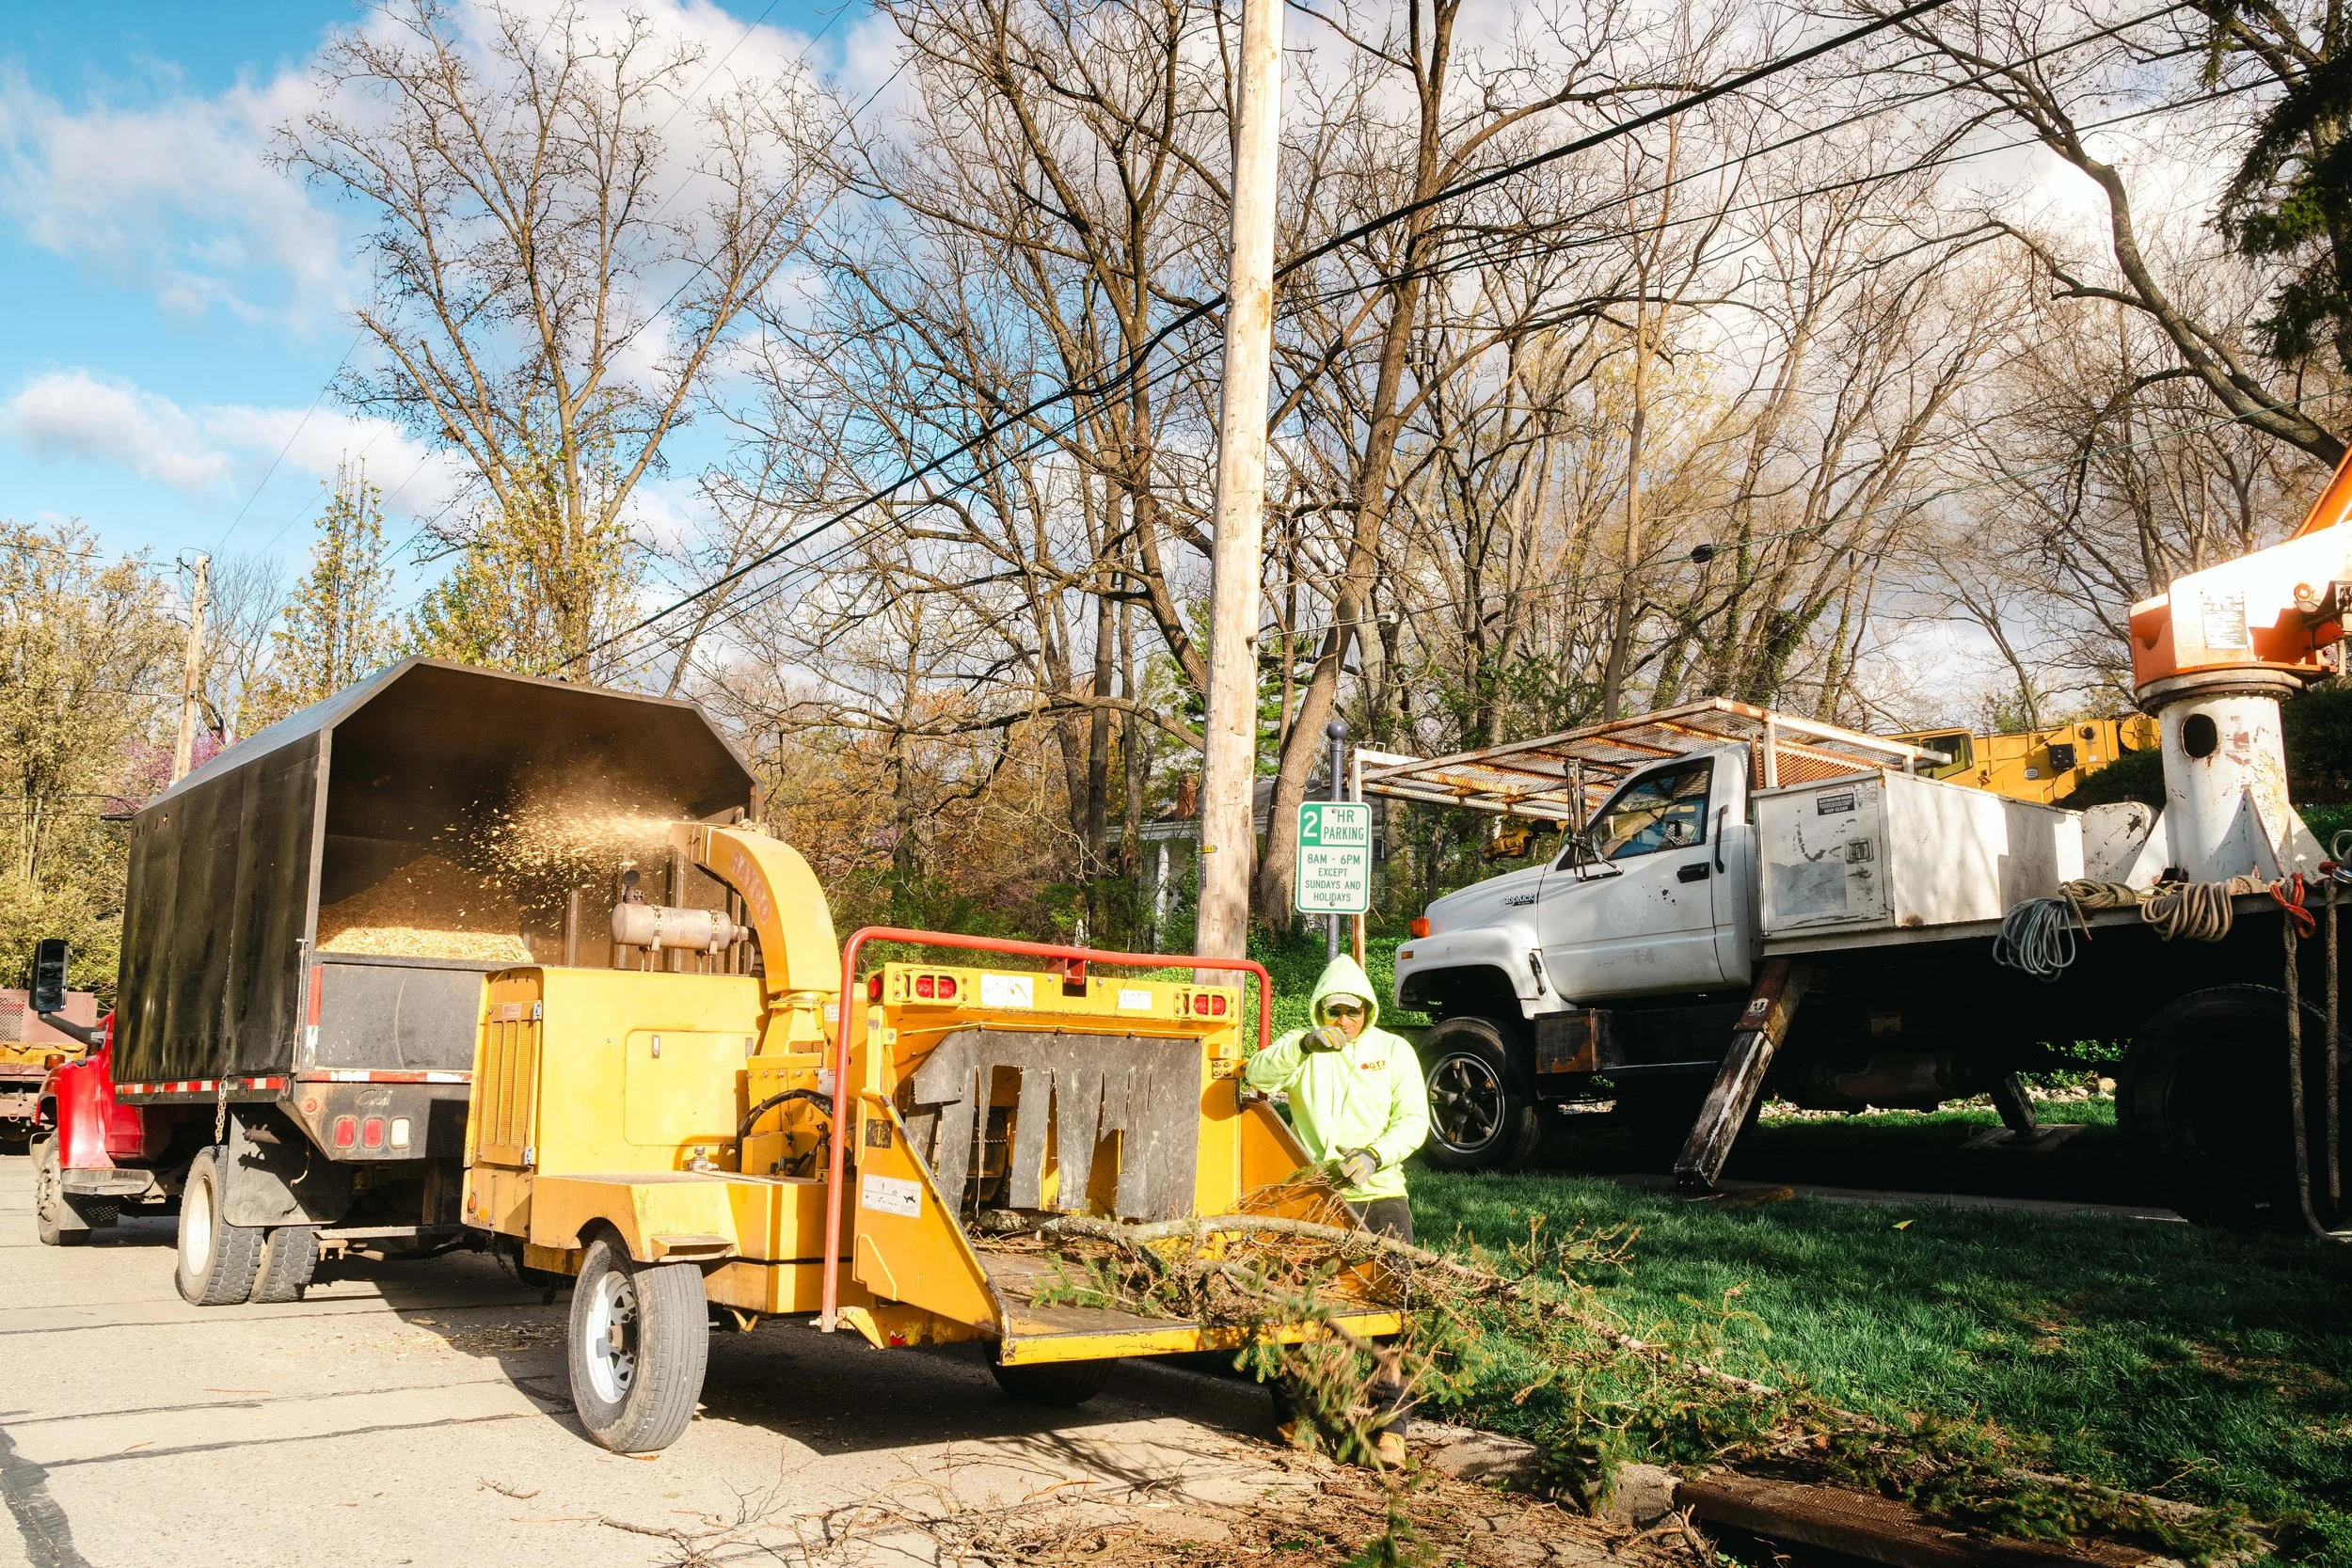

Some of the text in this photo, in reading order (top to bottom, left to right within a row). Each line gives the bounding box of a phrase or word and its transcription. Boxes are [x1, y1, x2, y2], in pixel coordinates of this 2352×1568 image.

[1337, 810, 1355, 823] HR
[1303, 811, 1318, 837] 2
[1324, 827, 1364, 840] PARKING
[1307, 853, 1327, 864] 8AM
[1340, 854, 1360, 865] 6PM
[1318, 867, 1348, 877] EXCEPT
[1305, 879, 1361, 890] SUNDAYS AND
[1313, 893, 1351, 902] HOLIDAYS
